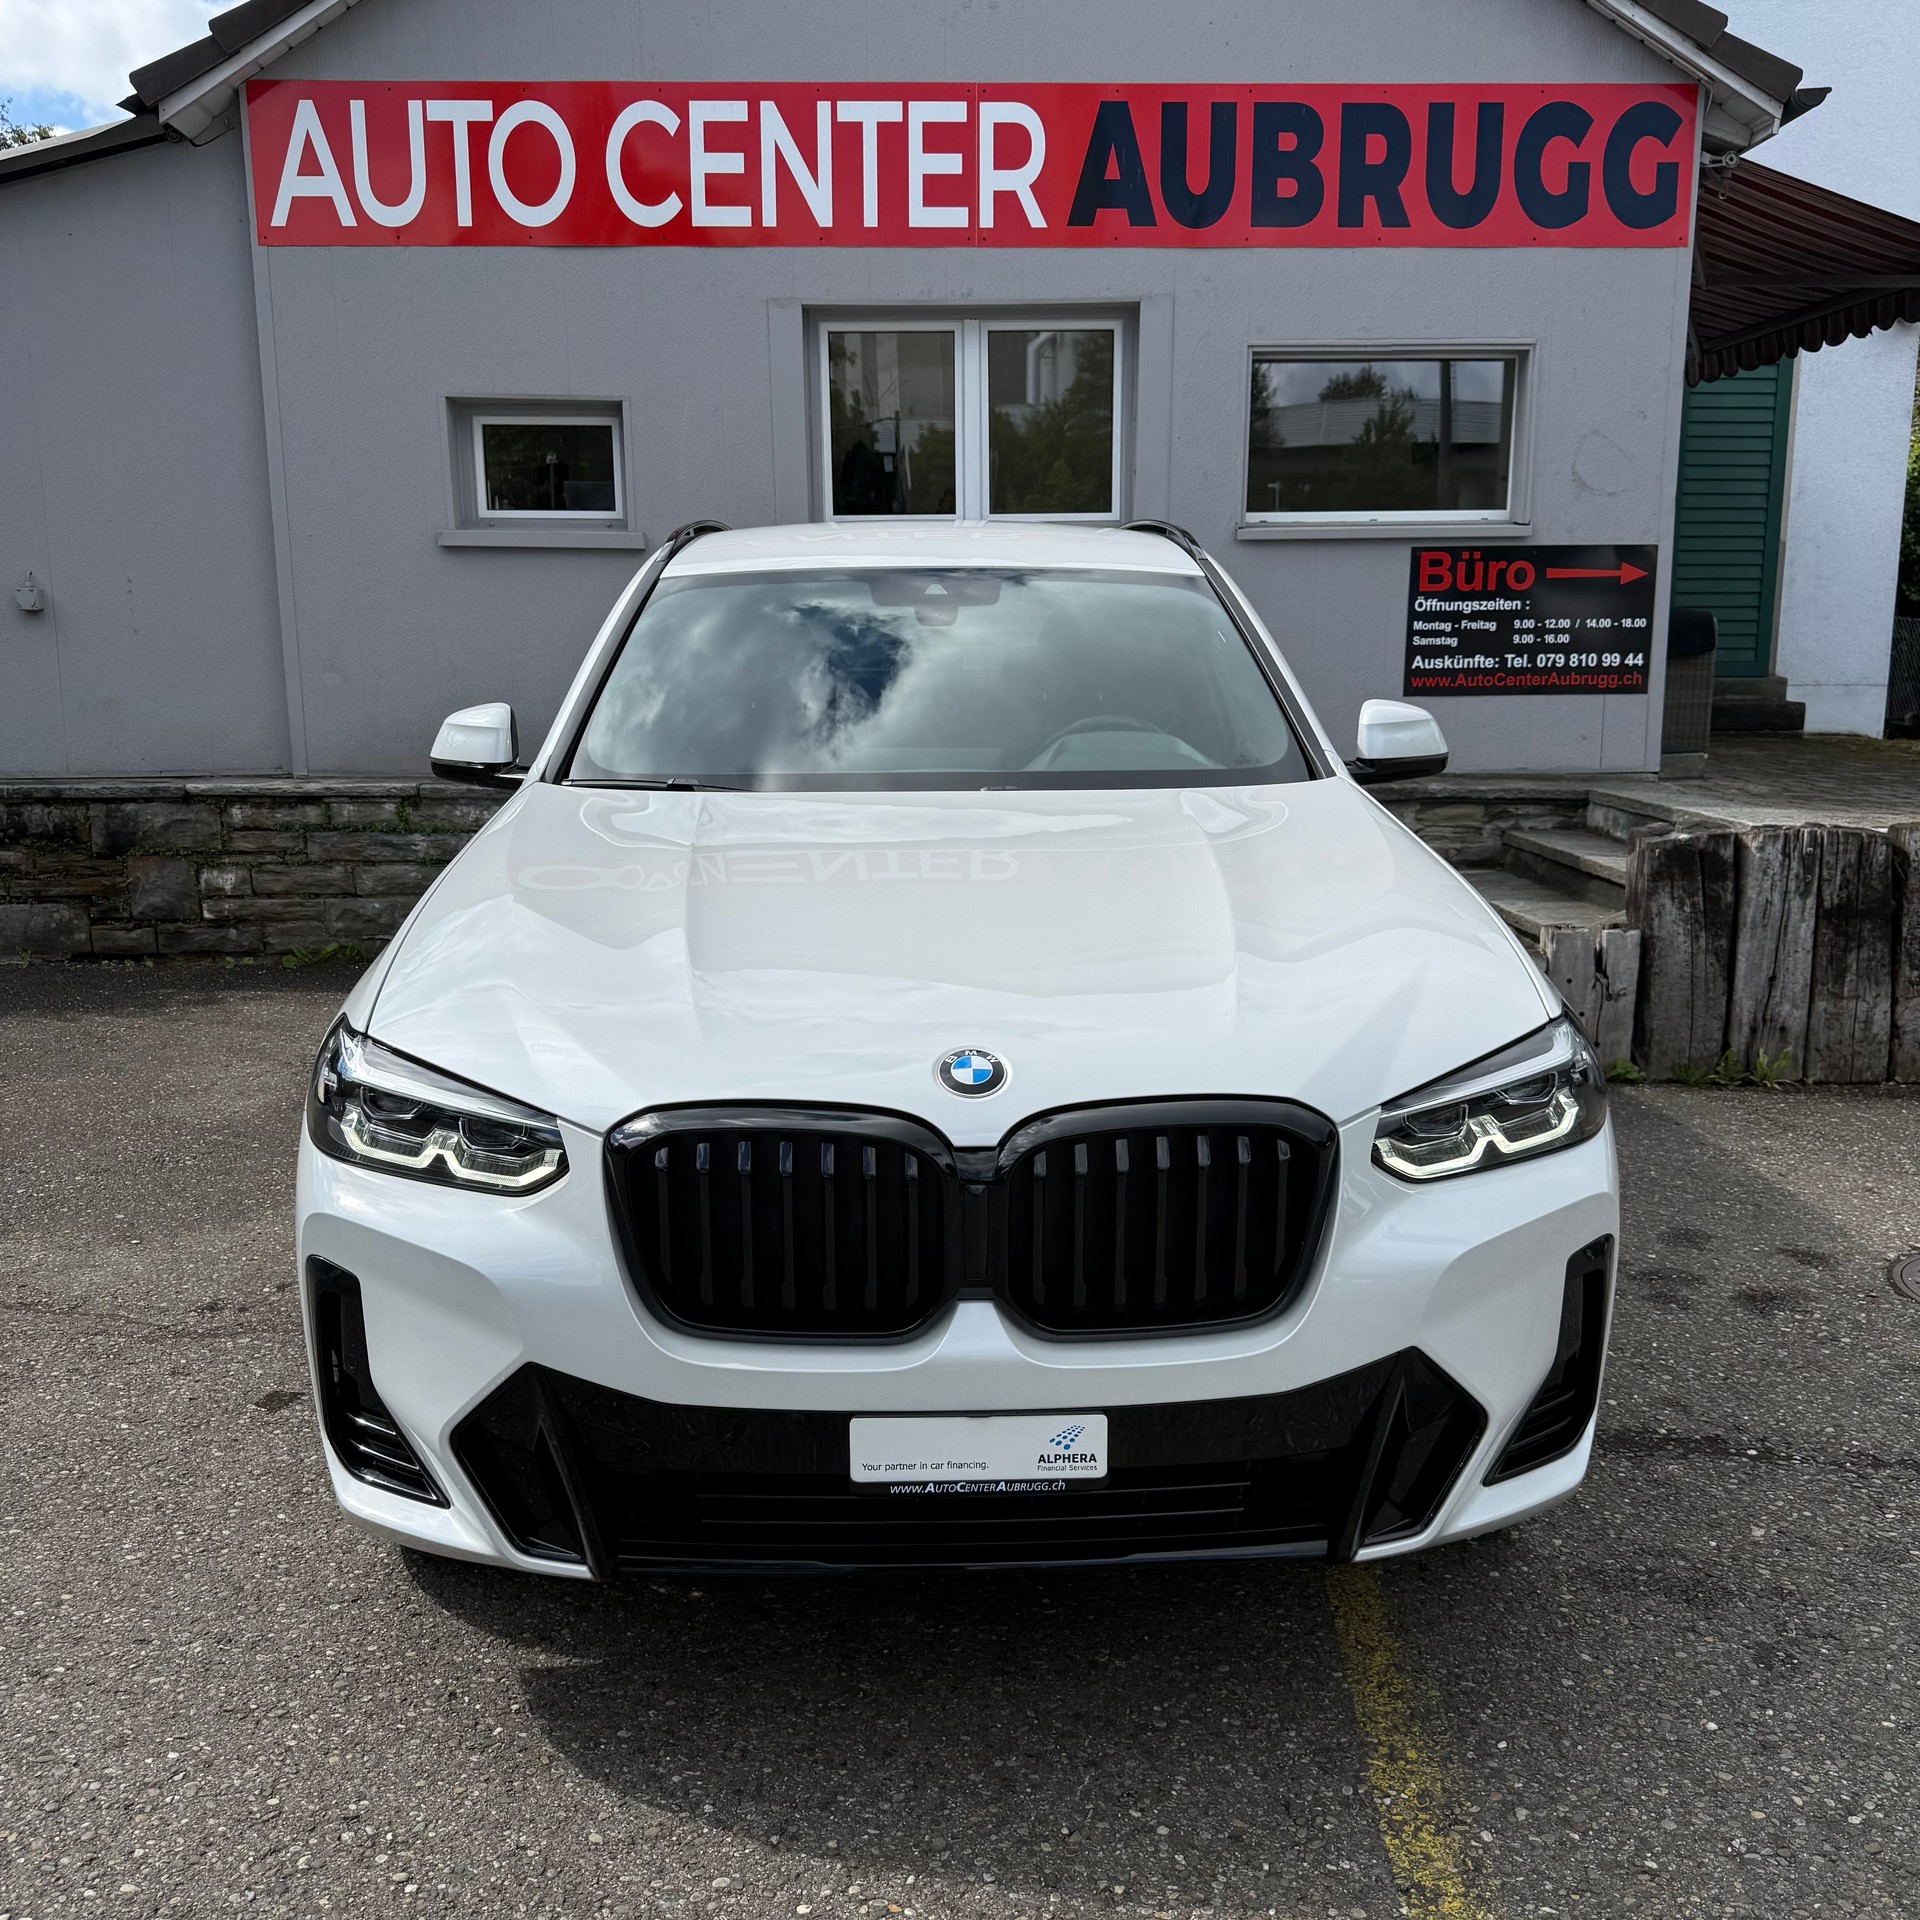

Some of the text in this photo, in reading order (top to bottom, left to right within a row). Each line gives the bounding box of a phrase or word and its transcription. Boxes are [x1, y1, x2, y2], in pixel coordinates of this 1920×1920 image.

[270, 99, 1683, 230] AUTO CENTER AUBRUGG
[1418, 551, 1535, 592] Büro
[1414, 596, 1521, 614] Öffnungszeiten
[1413, 620, 1452, 632] Montag
[1461, 620, 1497, 631] Freitag
[1513, 619, 1535, 629] 9.00
[1544, 618, 1571, 628] 12.00
[1585, 618, 1611, 628] 14.00
[1621, 618, 1647, 628] 18.00
[1412, 636, 1458, 647] Samstag
[1512, 634, 1534, 644] 9.00
[1543, 634, 1570, 644] 16.00
[1411, 652, 1644, 669] Auskünfte: Tel. 079 810 99 44
[1411, 671, 1642, 688] www.AutoCenterAubrugg.ch
[945, 1050, 999, 1063] BMW
[862, 1462, 882, 1471] Your
[885, 1462, 917, 1472] partner
[920, 1462, 927, 1470] in
[947, 1460, 989, 1470] financing.
[1038, 1453, 1097, 1464] ALPHERA
